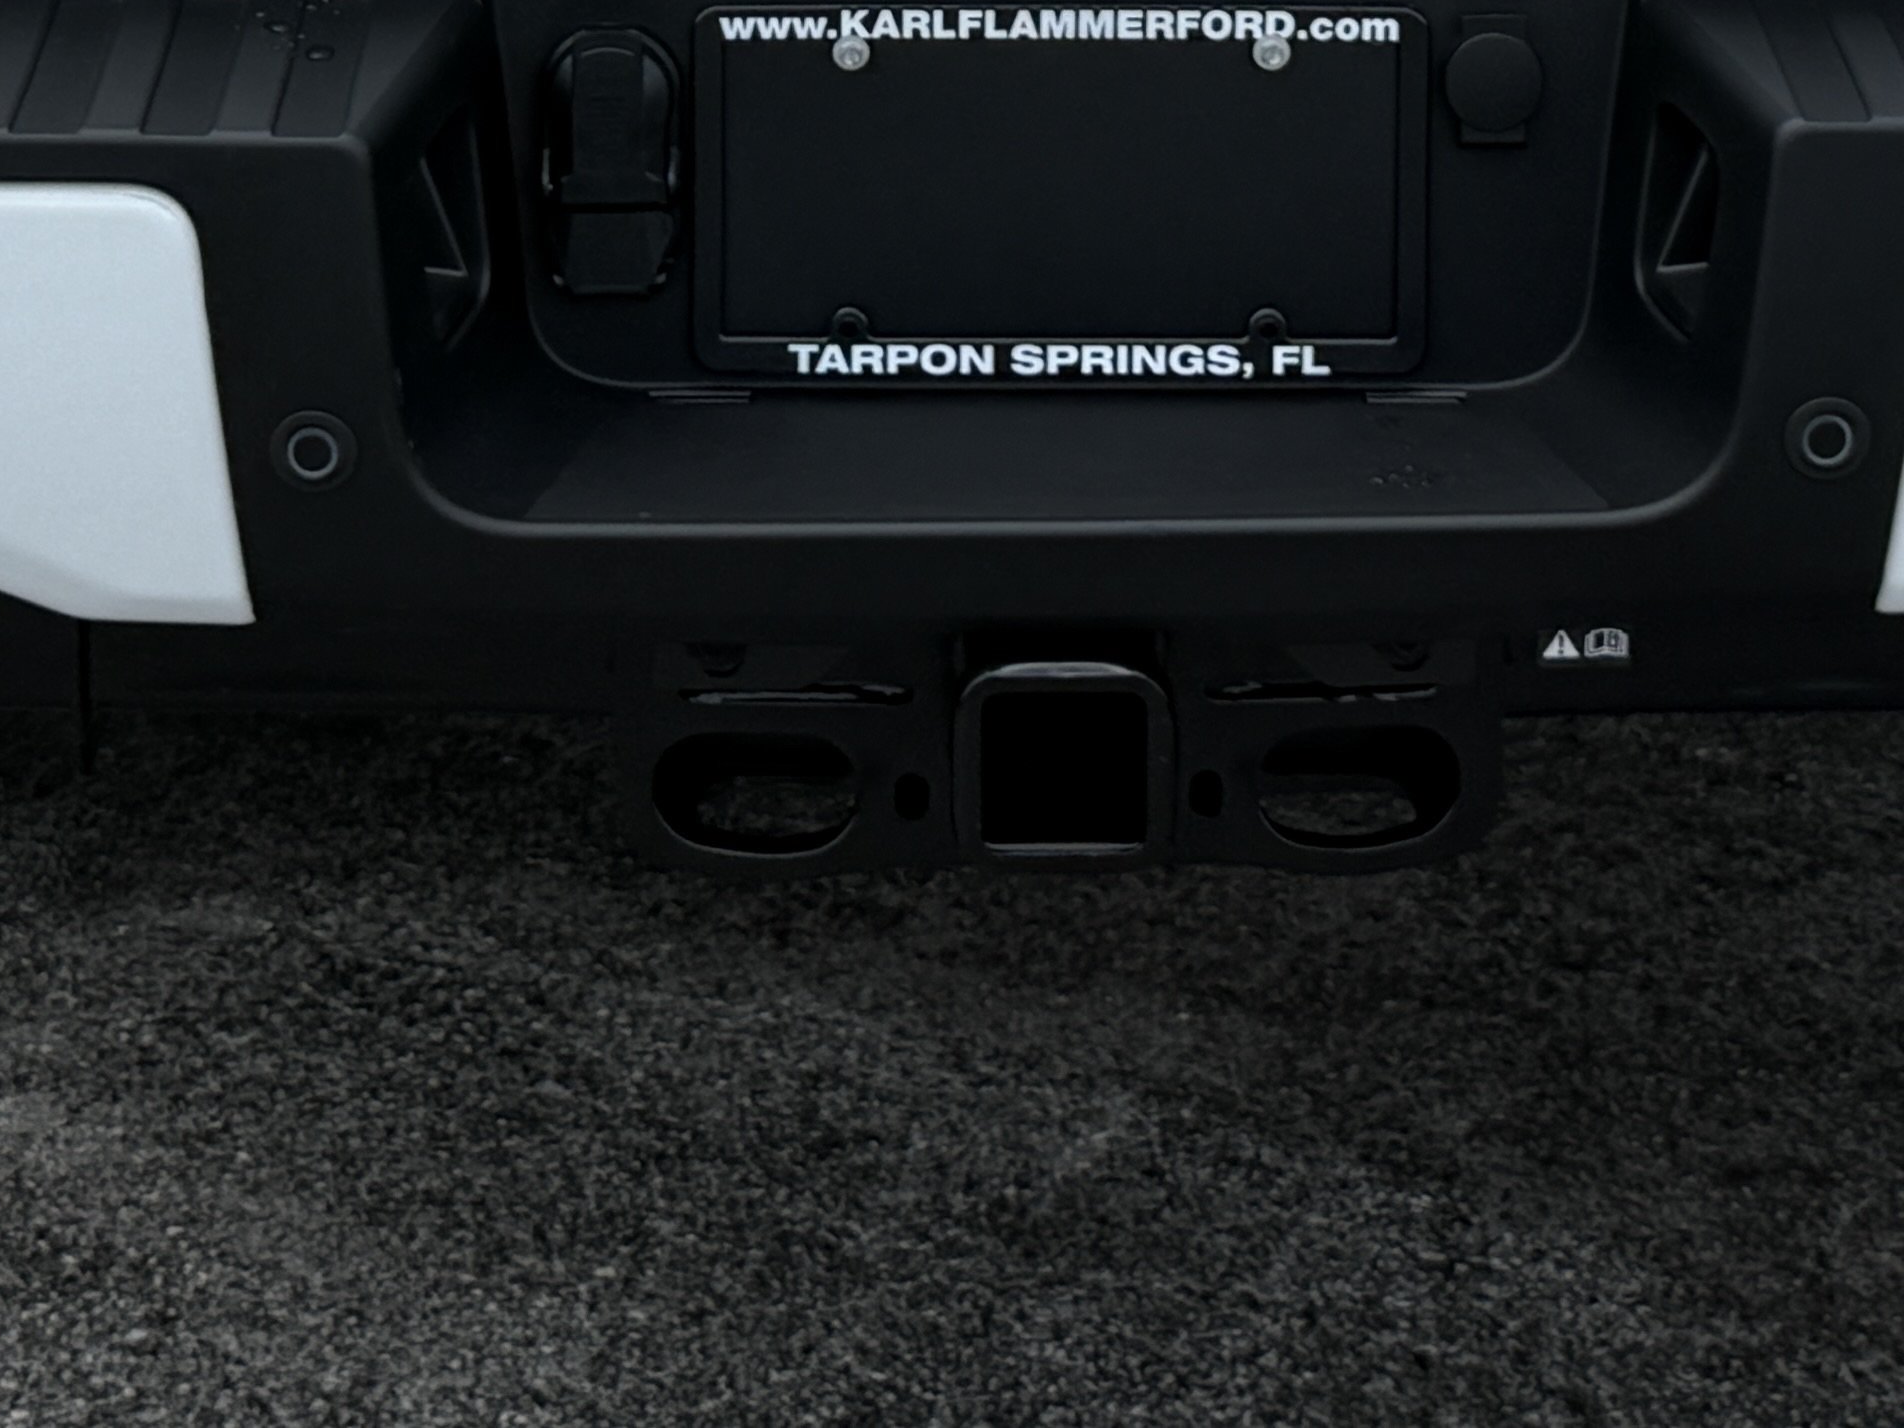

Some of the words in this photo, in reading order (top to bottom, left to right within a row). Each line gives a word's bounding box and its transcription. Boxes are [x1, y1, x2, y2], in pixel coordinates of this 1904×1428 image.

[719, 9, 1401, 42] www.KARLFLAMMERFORD.com
[788, 343, 995, 376] TARPON
[1010, 343, 1254, 379] SPRINGS,
[1272, 344, 1331, 376] FL
